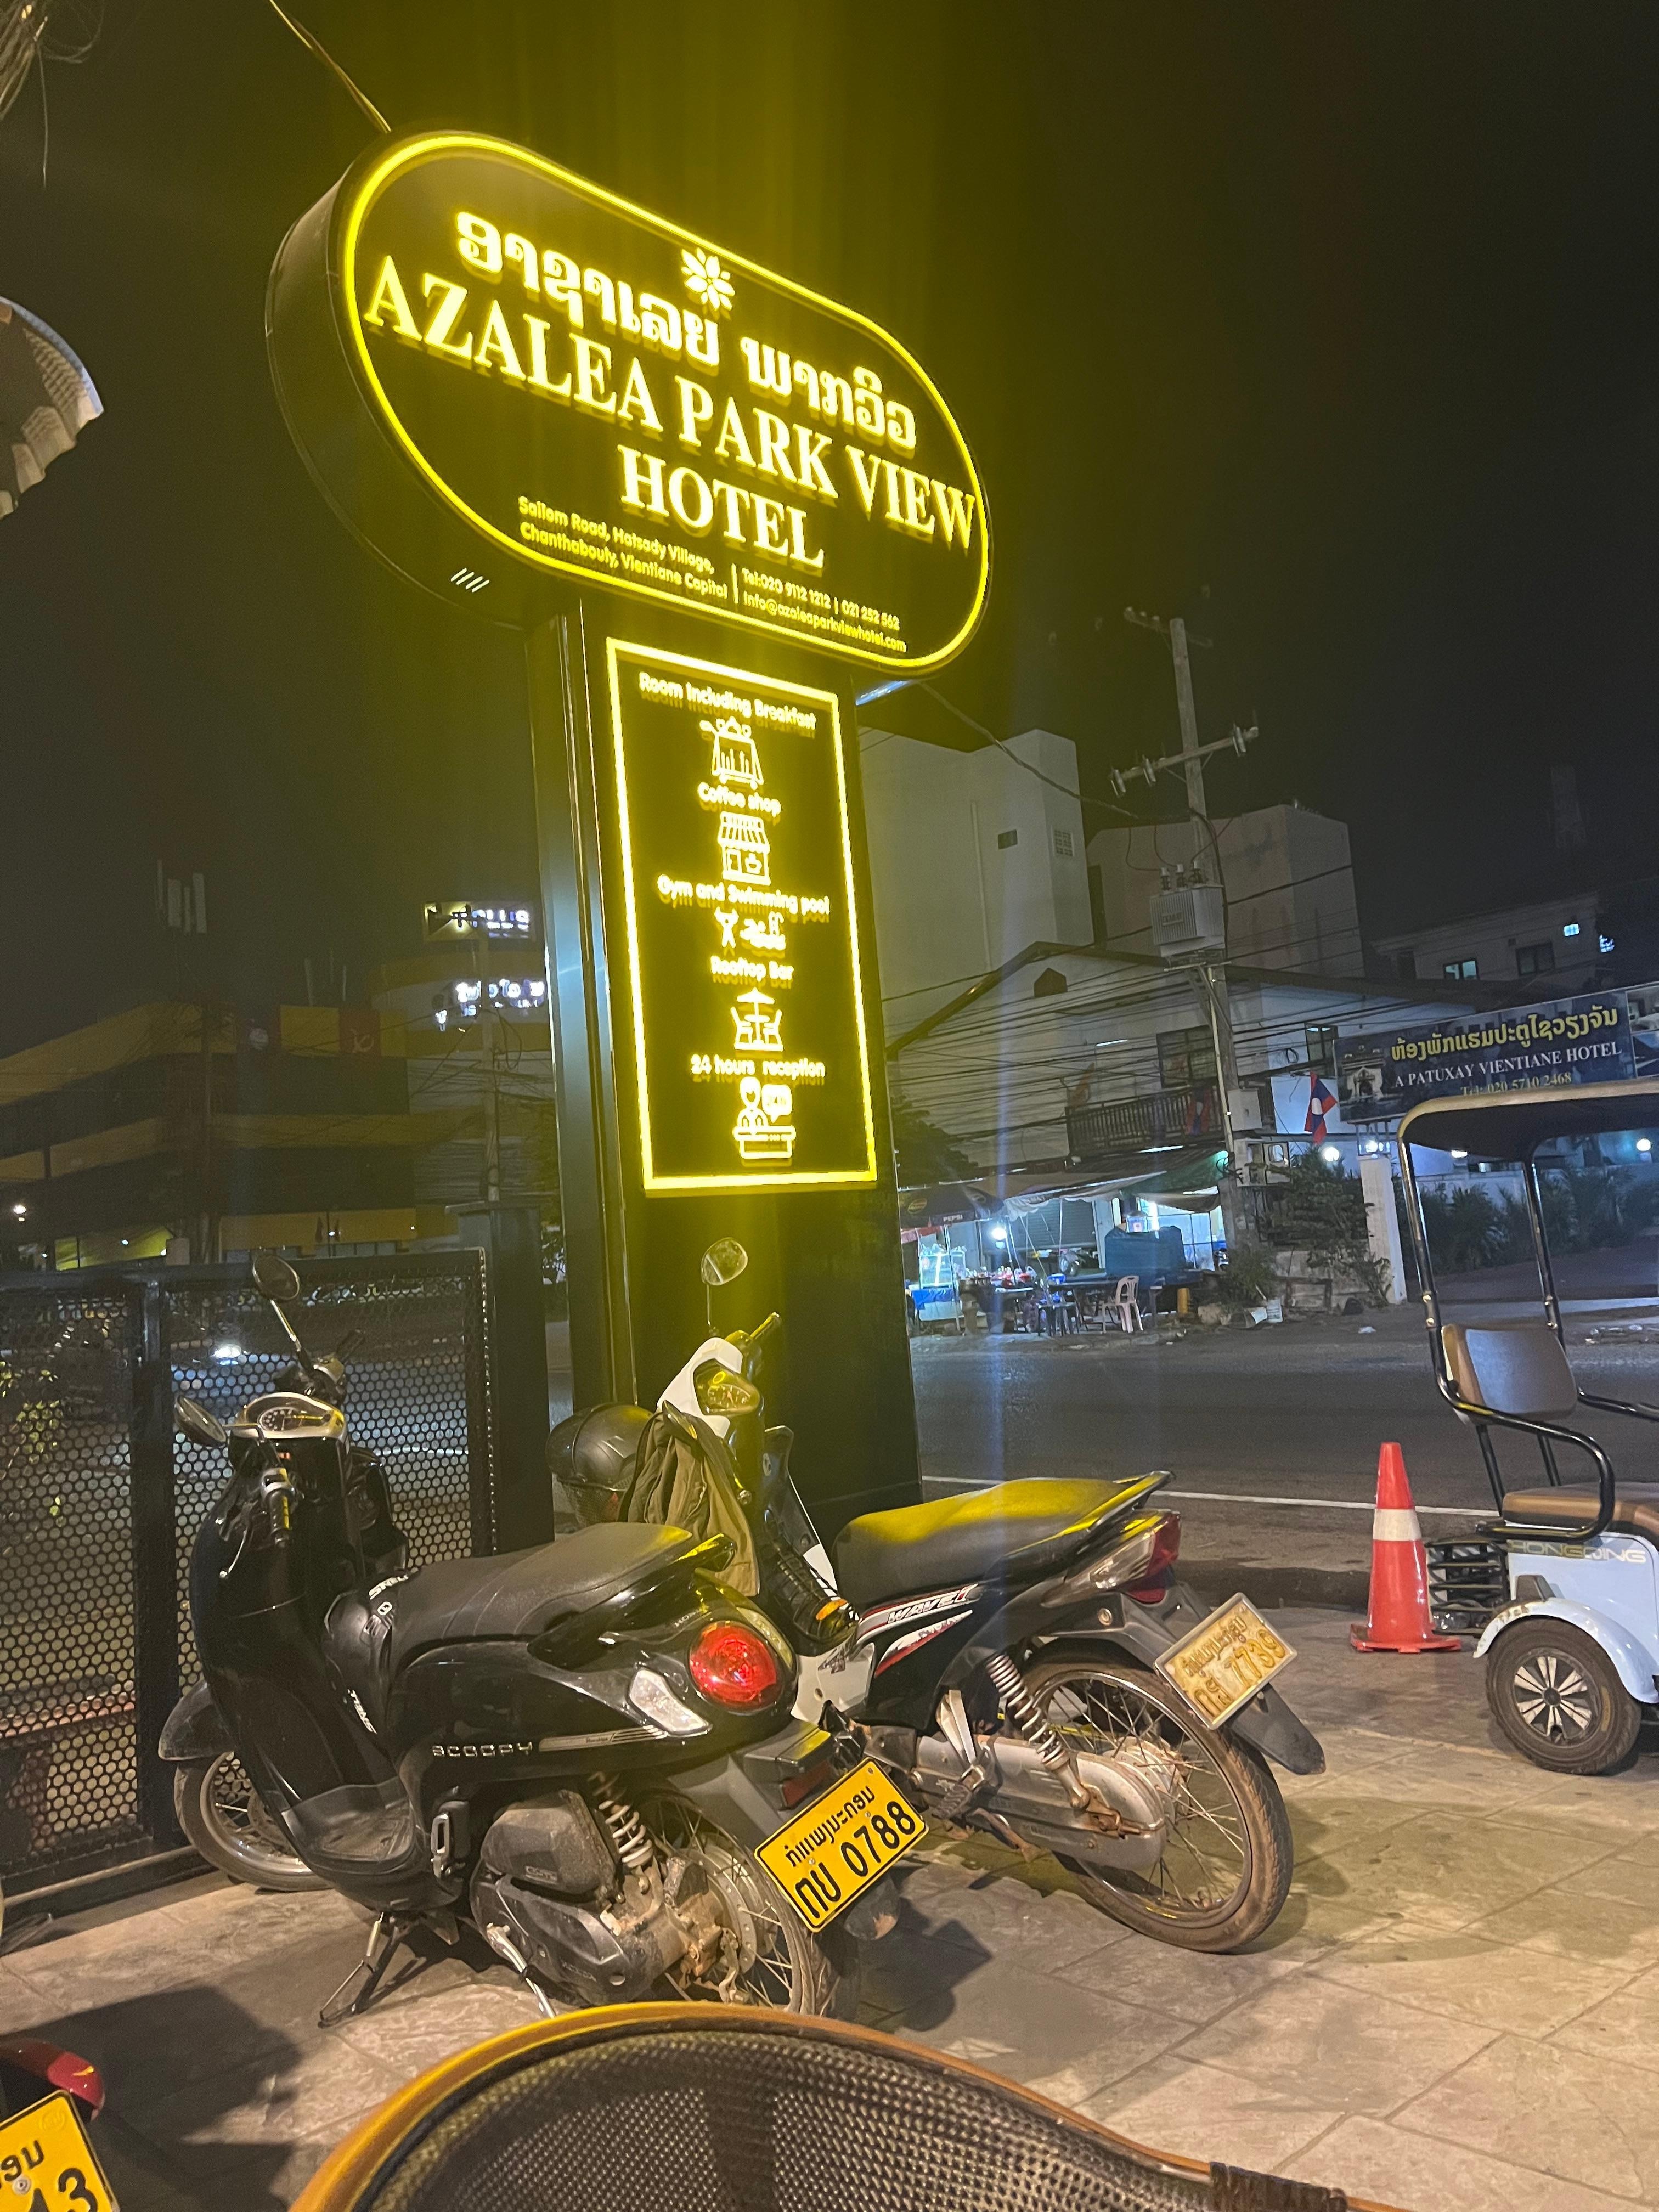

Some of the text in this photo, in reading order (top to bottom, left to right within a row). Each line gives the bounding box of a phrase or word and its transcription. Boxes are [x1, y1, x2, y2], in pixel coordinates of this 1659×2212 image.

[364, 256, 975, 548] AZALEA PARK VIEW
[618, 445, 823, 568] HOTEL
[518, 496, 714, 574] Sailom Road, Hatsady Village,
[621, 552, 682, 585] Vientiane
[685, 573, 727, 599] Capital
[639, 672, 816, 730] Room Including Breakfast
[698, 782, 781, 817] Coffee shop
[657, 874, 830, 916] Gym and Swimming pool
[711, 956, 793, 981] Rooftop Bar
[691, 1054, 826, 1080] 24 hours reception
[1395, 1042, 1623, 1088] A PATUXAY VIENTIANE HOTEL
[1487, 1081, 1508, 1093] 020
[1541, 1071, 1572, 1086] 2468
[432, 1741, 533, 1757] SCOOPY
[840, 1801, 916, 1877] 0788
